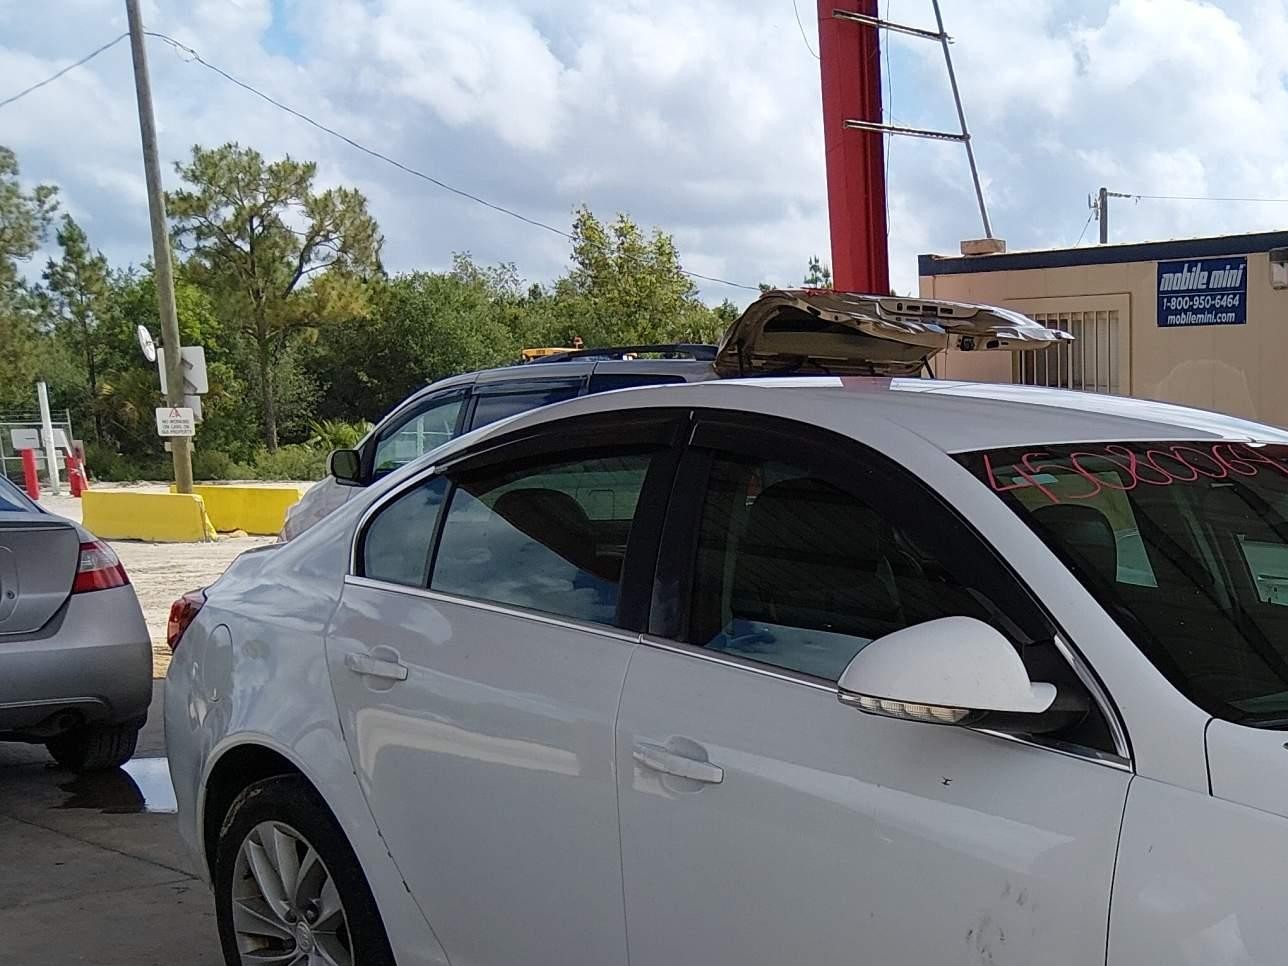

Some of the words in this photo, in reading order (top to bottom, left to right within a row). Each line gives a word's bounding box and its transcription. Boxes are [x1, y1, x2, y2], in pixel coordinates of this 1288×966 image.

[1160, 263, 1208, 291] mobile
[1209, 264, 1244, 289] mini
[1163, 294, 1240, 310] 1-800-950-6464
[1167, 311, 1235, 325] mobilemini.com
